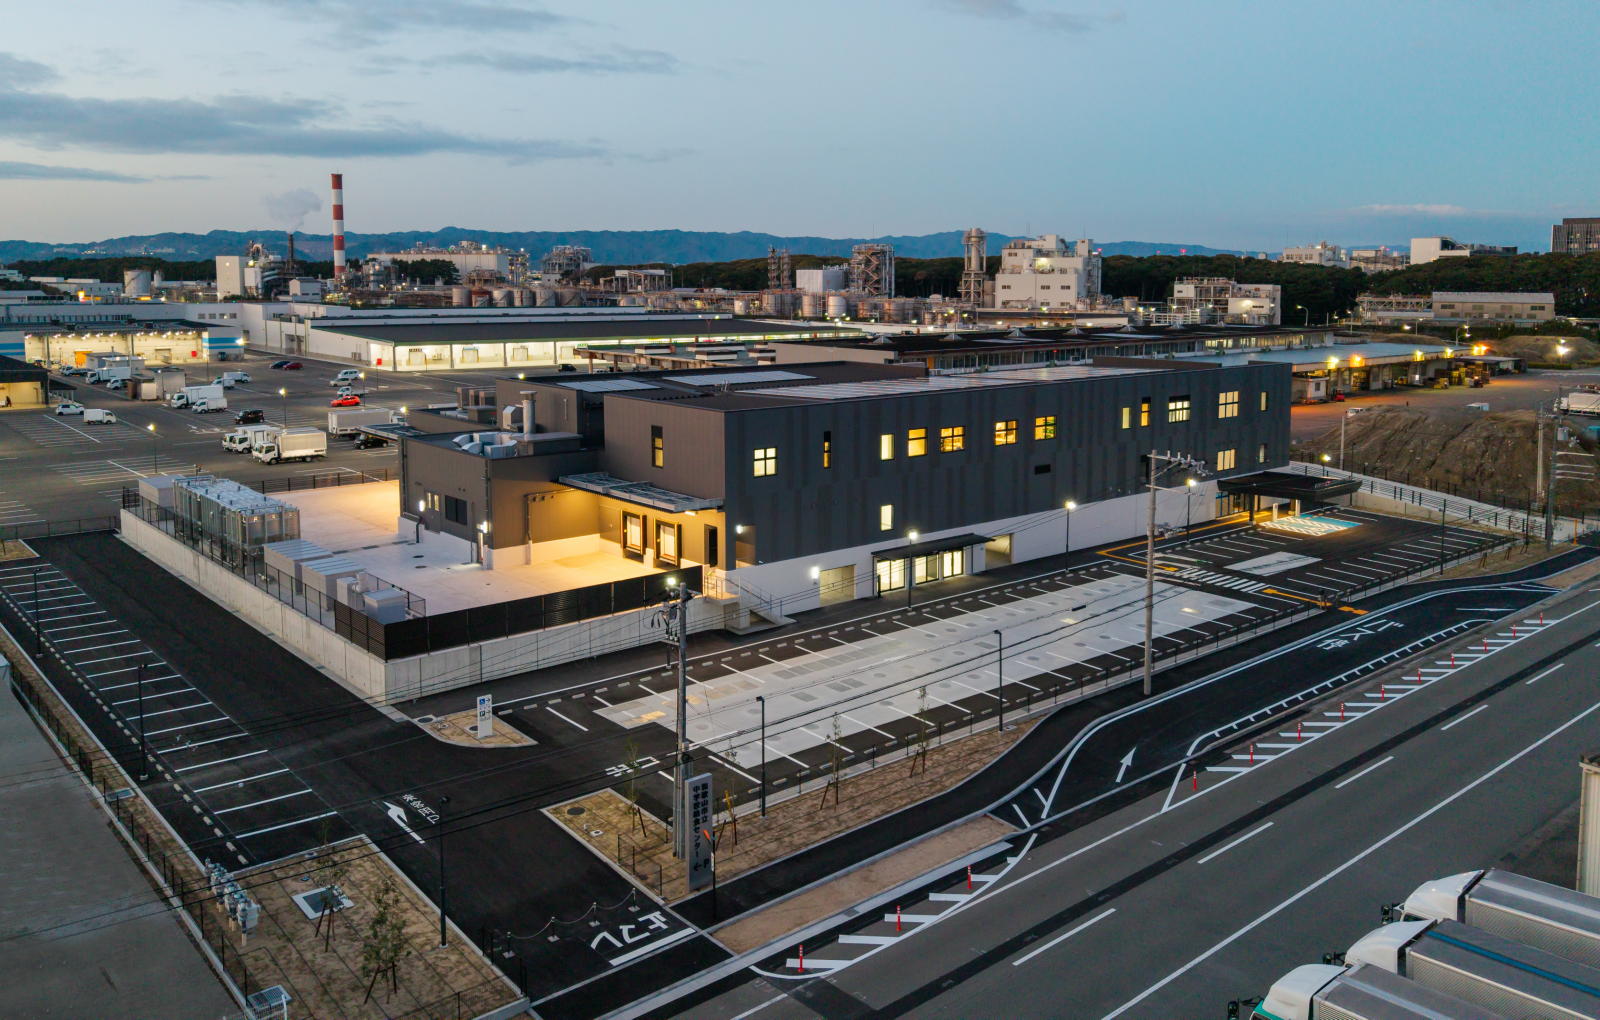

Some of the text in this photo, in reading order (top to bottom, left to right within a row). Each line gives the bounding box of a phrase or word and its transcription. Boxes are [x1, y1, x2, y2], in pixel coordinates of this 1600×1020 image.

[1316, 619, 1404, 650] バス停
[604, 756, 660, 777] 出口
[590, 910, 669, 951] 止マレ
